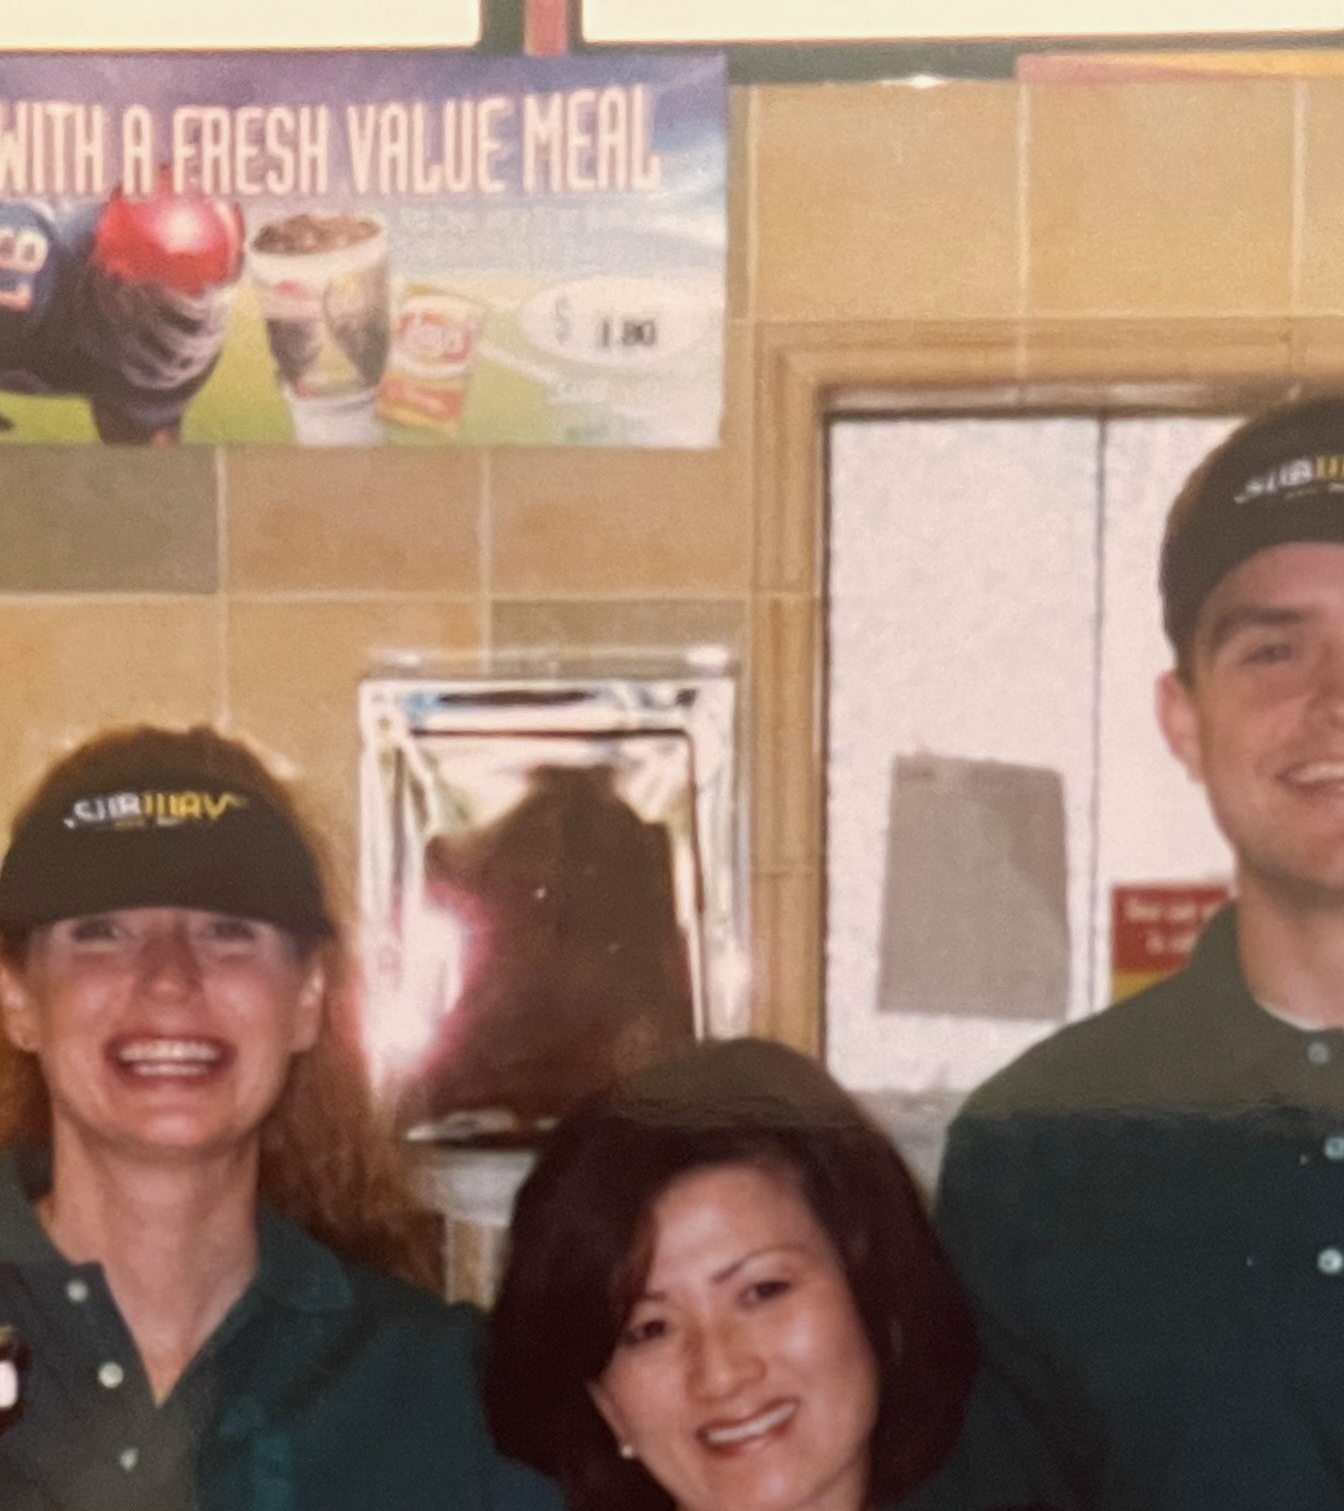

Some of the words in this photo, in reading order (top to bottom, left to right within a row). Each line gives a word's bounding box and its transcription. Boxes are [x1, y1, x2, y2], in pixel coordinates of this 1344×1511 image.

[121, 102, 153, 196] A
[172, 102, 330, 196] FRESH
[346, 97, 514, 195] VALUE
[522, 82, 662, 193] MEAL
